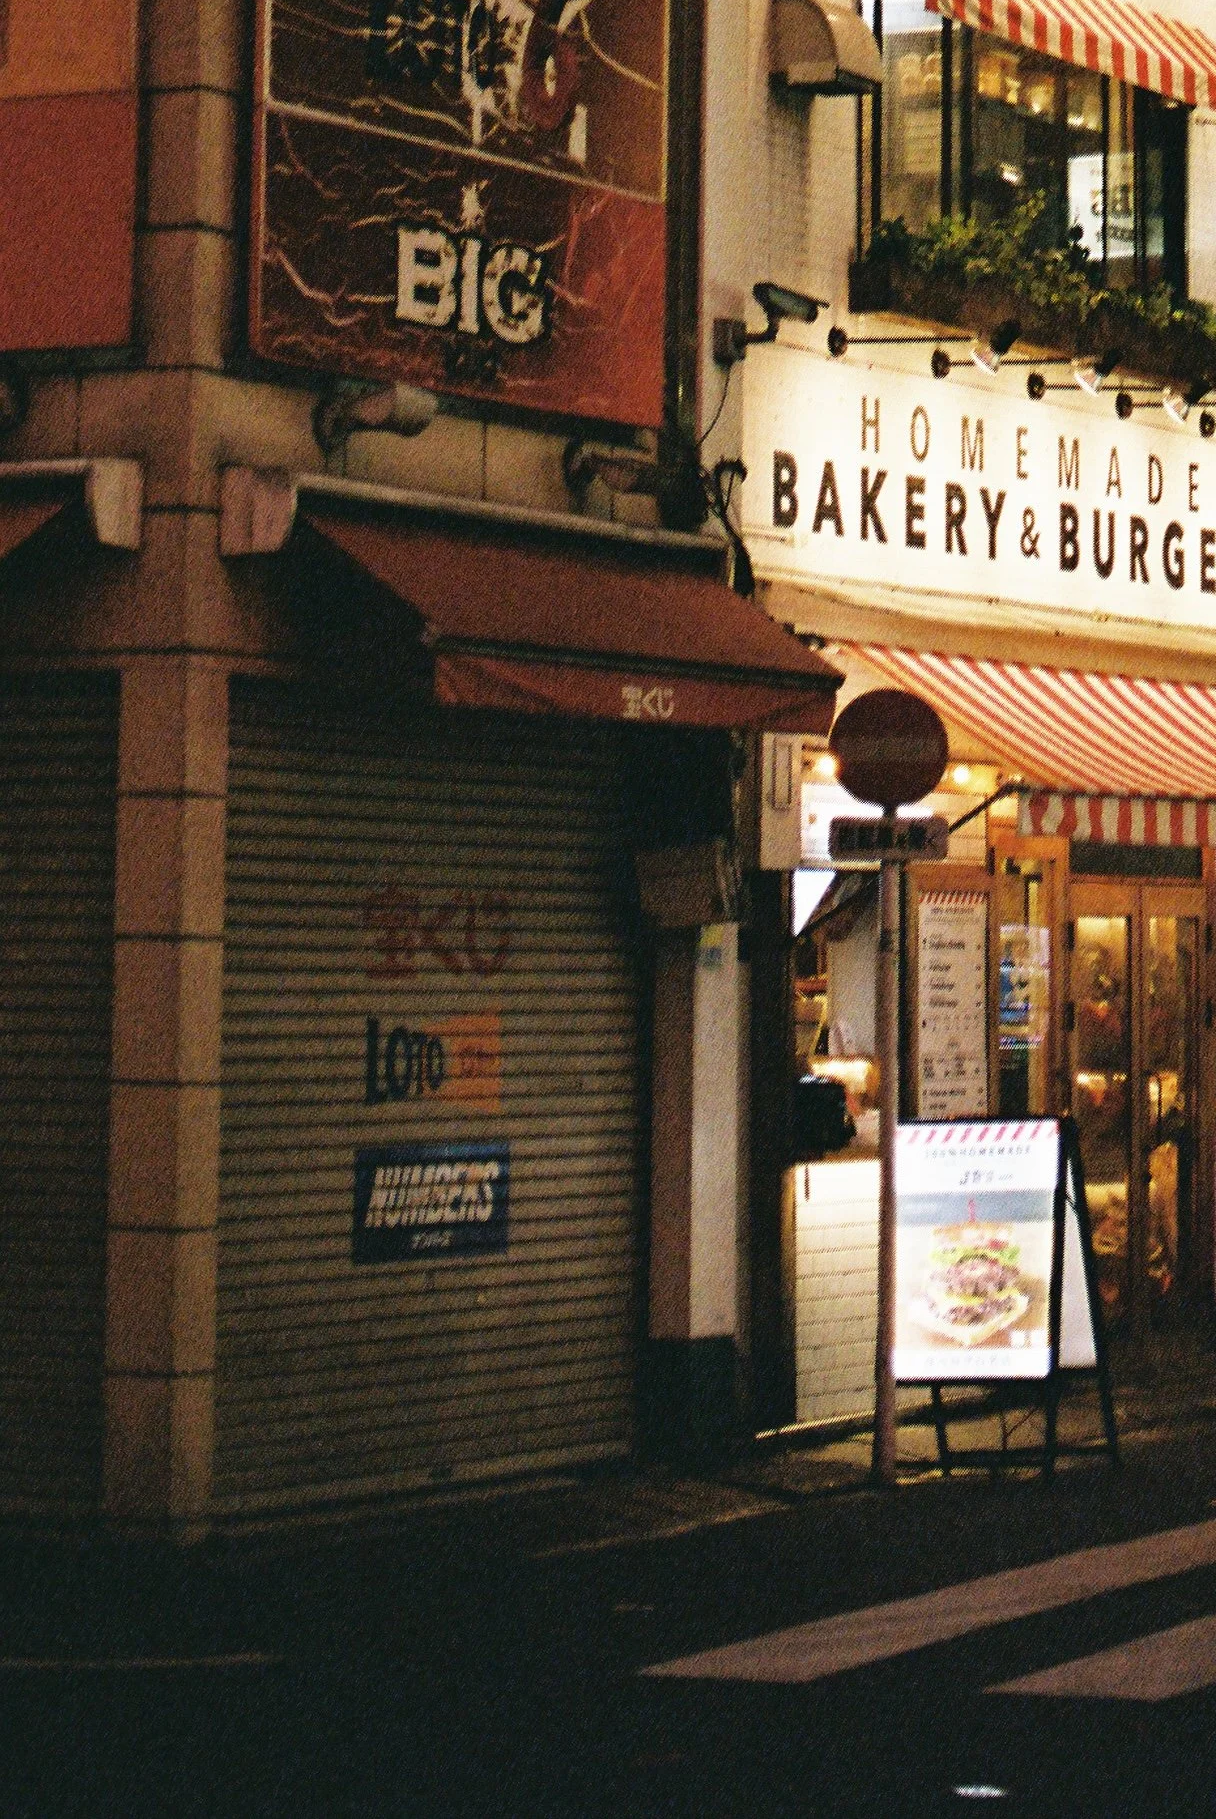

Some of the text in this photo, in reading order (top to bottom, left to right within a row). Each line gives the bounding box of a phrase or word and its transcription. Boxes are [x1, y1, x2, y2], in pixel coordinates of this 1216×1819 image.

[394, 227, 546, 344] BIG
[772, 449, 1007, 561] BAKERY
[1019, 505, 1041, 560] &
[861, 395, 1200, 513] HOMEMADE
[364, 1160, 501, 1228] NUMBERS
